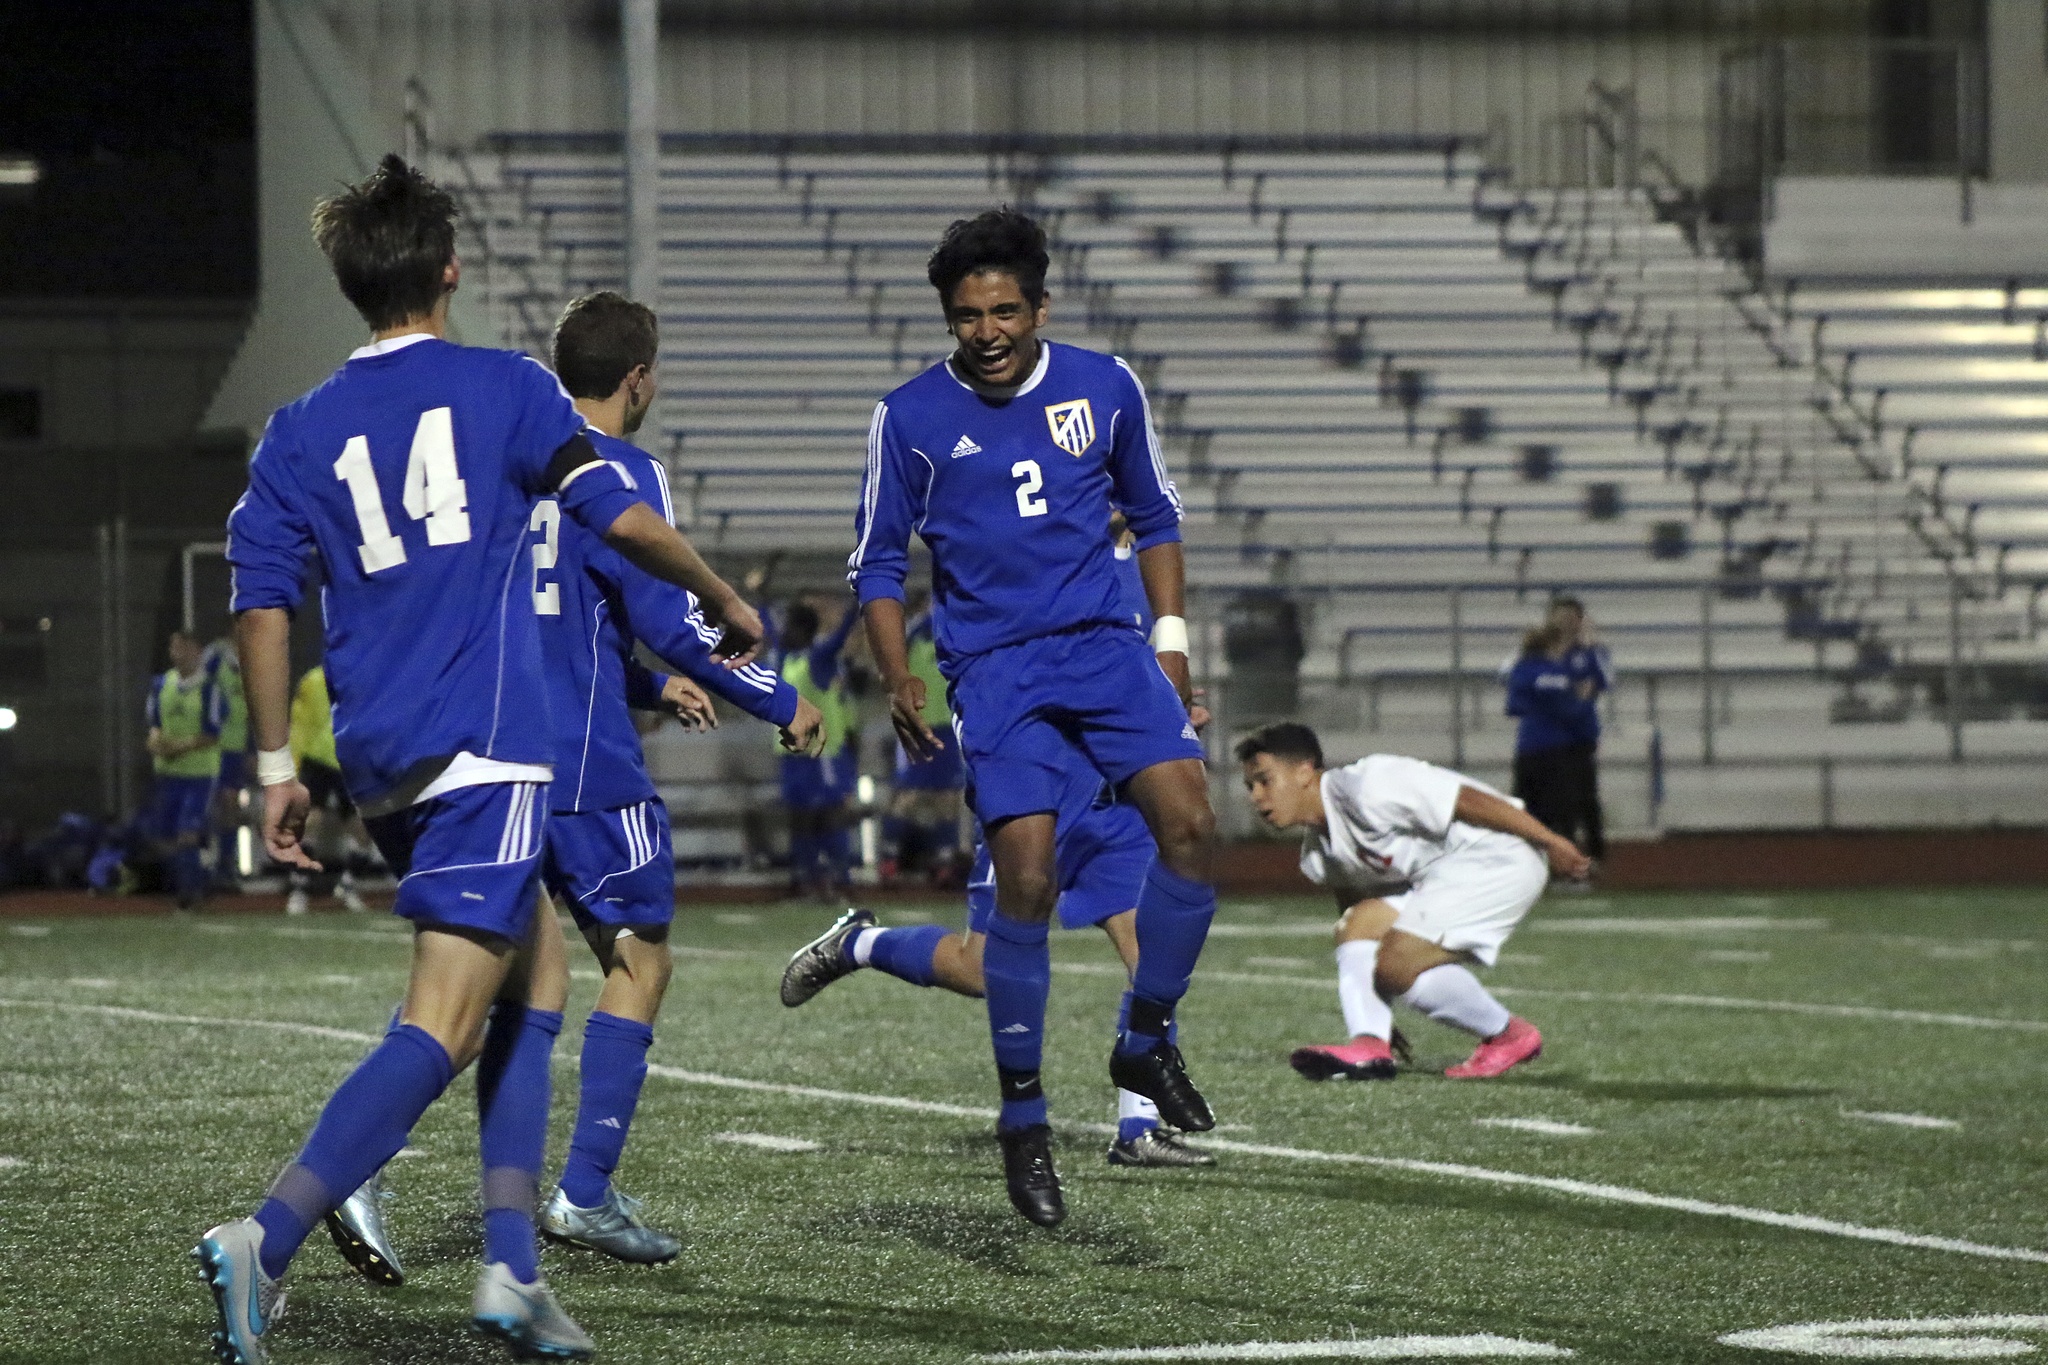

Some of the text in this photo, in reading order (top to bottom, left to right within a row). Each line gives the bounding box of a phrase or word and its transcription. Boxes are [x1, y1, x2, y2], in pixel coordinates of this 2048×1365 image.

[332, 406, 471, 574] 14
[951, 445, 982, 459] adidas
[1011, 459, 1047, 517] 2
[529, 500, 561, 615] 2
